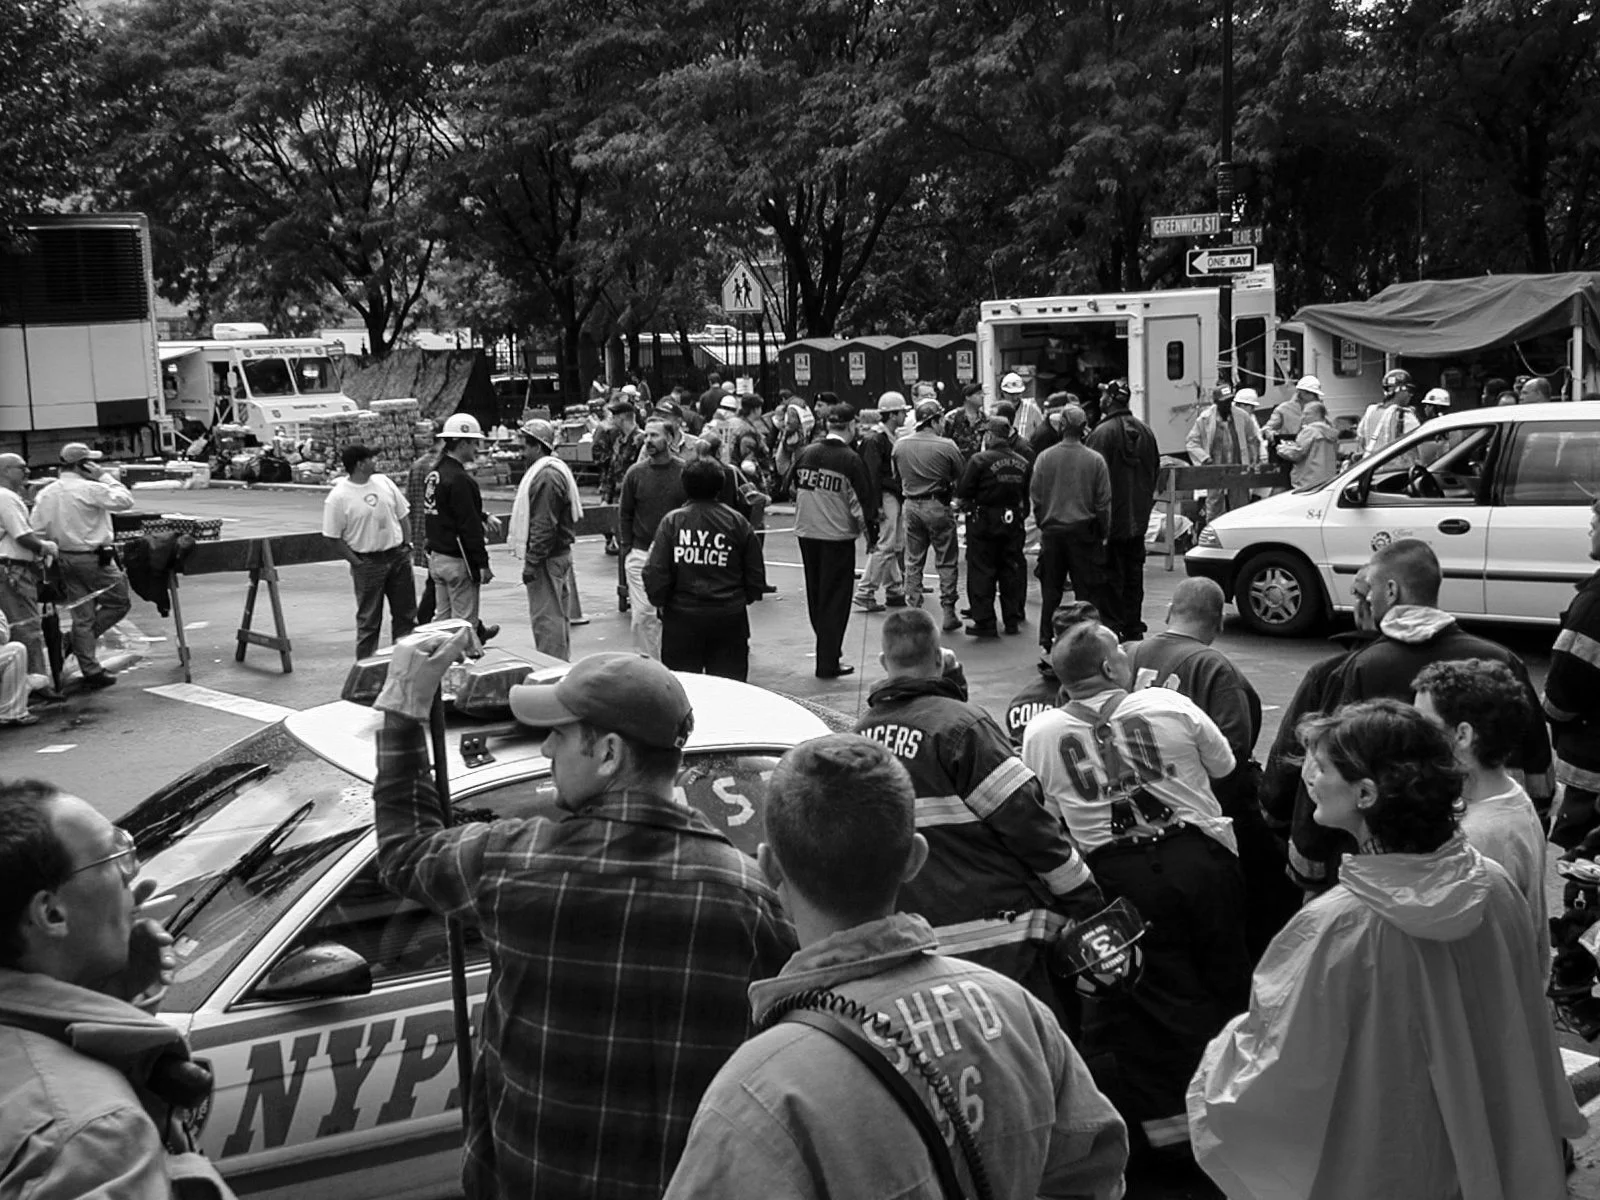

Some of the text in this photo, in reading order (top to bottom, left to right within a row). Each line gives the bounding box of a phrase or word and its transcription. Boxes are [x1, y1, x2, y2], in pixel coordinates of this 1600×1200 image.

[1153, 216, 1217, 235] GREENWICH ST
[1207, 255, 1249, 267] ONE WAY
[679, 529, 732, 550] N.Y.C.
[674, 546, 729, 567] POLICE
[220, 1003, 482, 1158] NYP
